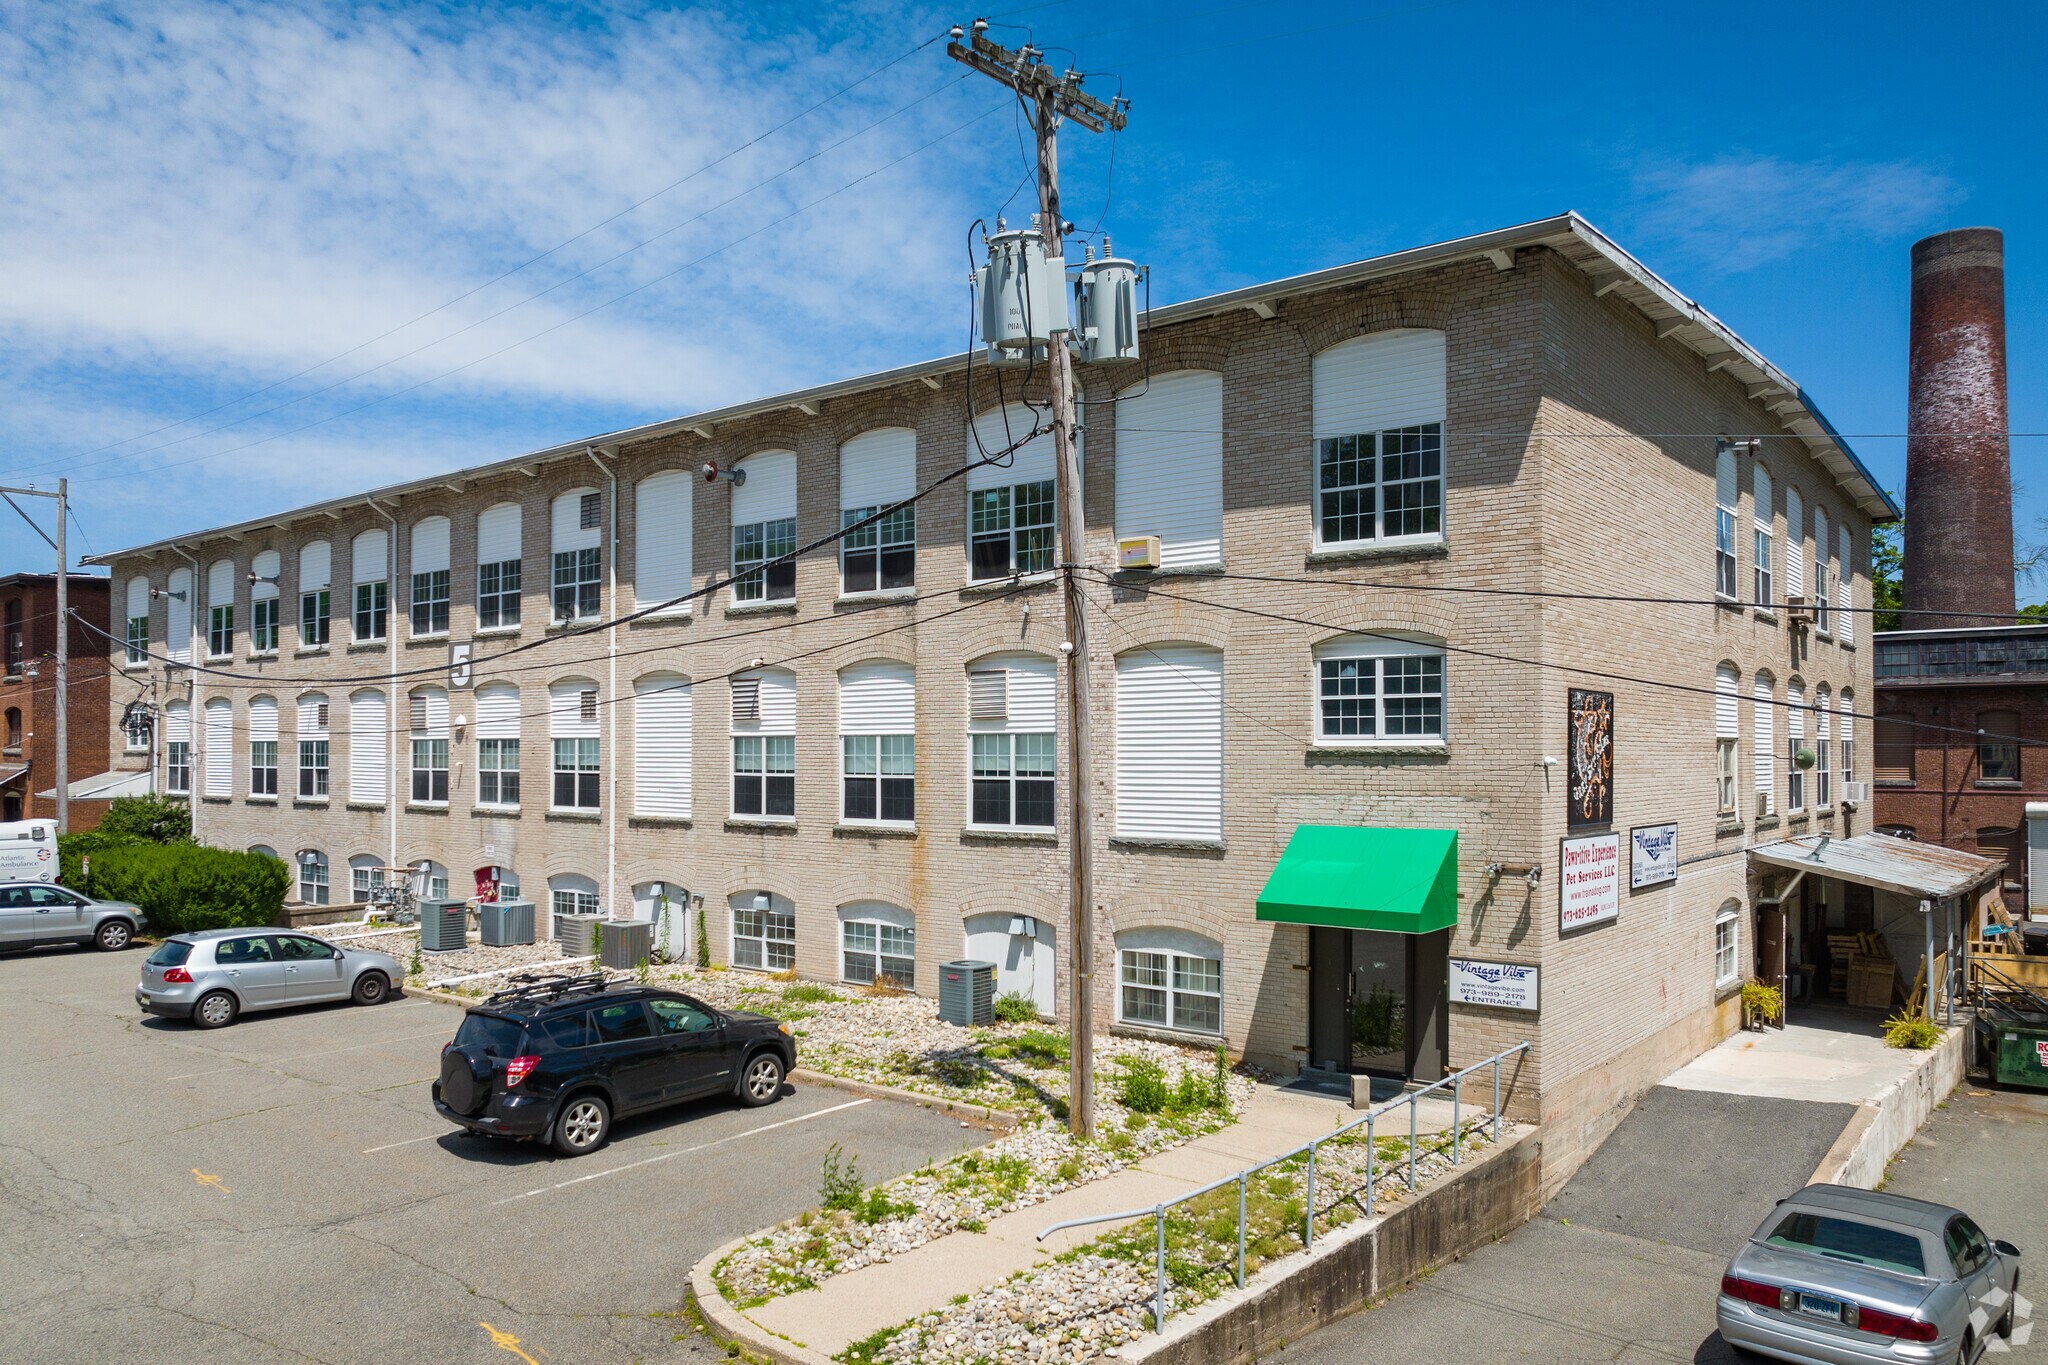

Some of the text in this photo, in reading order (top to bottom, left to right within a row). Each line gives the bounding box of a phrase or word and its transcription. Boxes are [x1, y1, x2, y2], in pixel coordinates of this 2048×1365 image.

[451, 645, 470, 686] 5
[1592, 842, 1617, 865] Experience
[1566, 864, 1615, 886] Pet Services LLC
[1461, 961, 1525, 979] Vintage Vibe
[1460, 988, 1526, 1000] 973-989-2178
[1461, 982, 1525, 993] www.vintagevibe.com
[1472, 996, 1522, 1007] ENTRANCE
